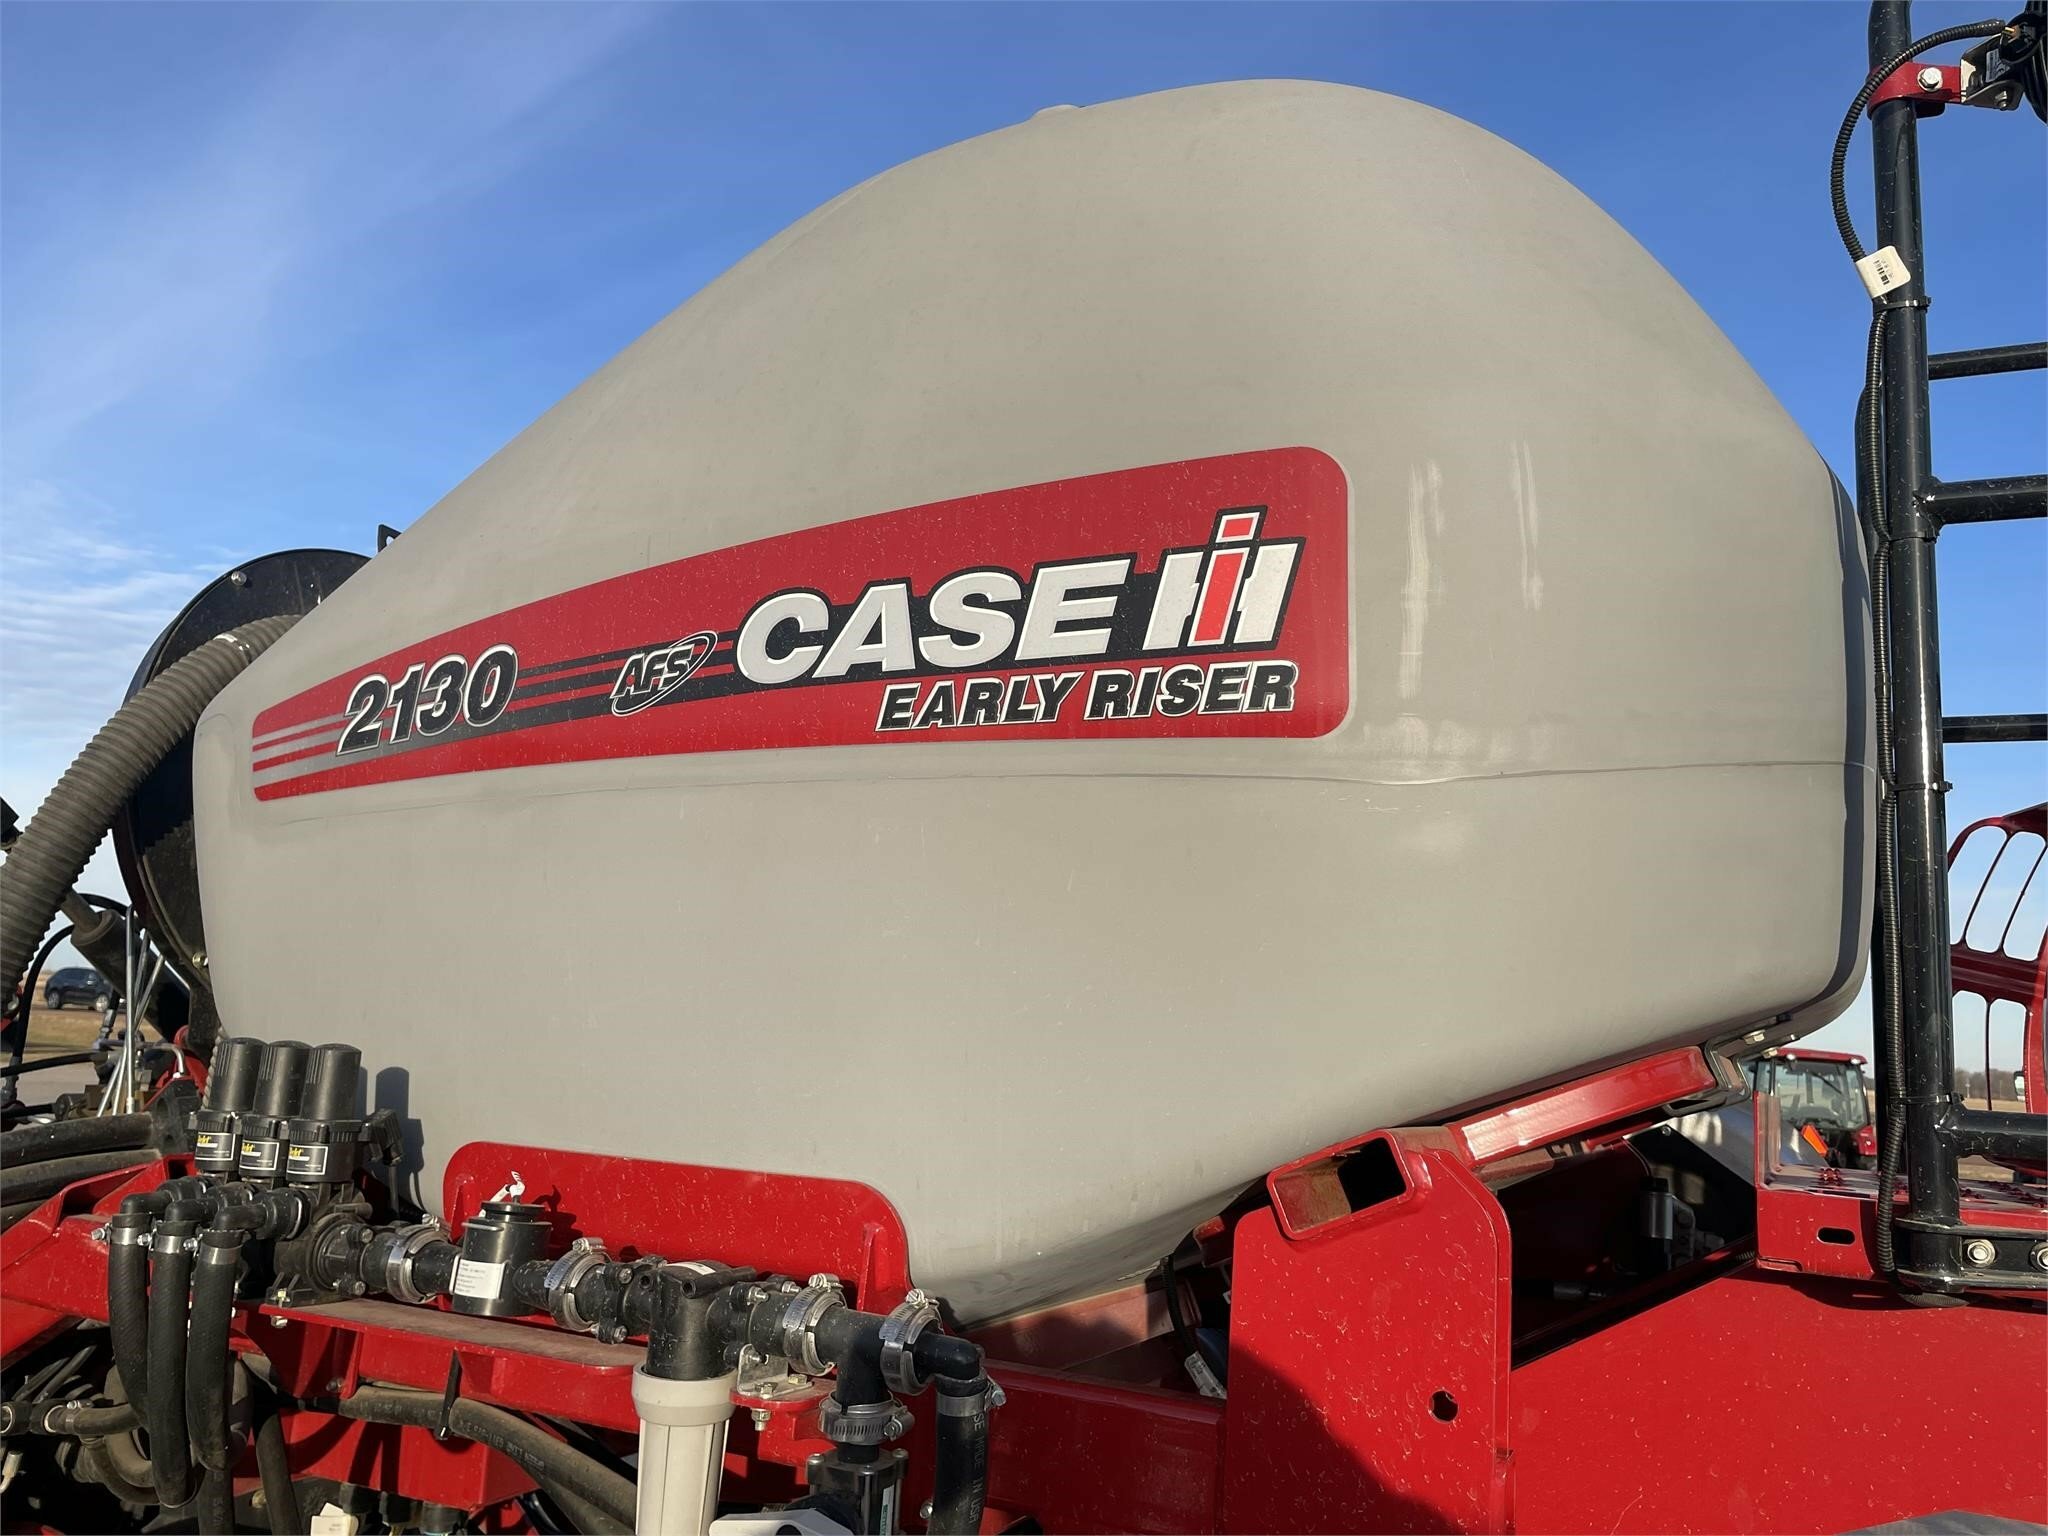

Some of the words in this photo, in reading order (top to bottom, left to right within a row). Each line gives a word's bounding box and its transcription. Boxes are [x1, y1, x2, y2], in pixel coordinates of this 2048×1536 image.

[336, 643, 519, 756] 2130
[612, 645, 695, 699] AFS
[736, 559, 1132, 685] CASE
[876, 672, 1081, 731] EARLY
[1084, 661, 1299, 720] RISER
[973, 1413, 985, 1431] SE
[972, 1477, 984, 1494] IN
[968, 1498, 983, 1524] USA
